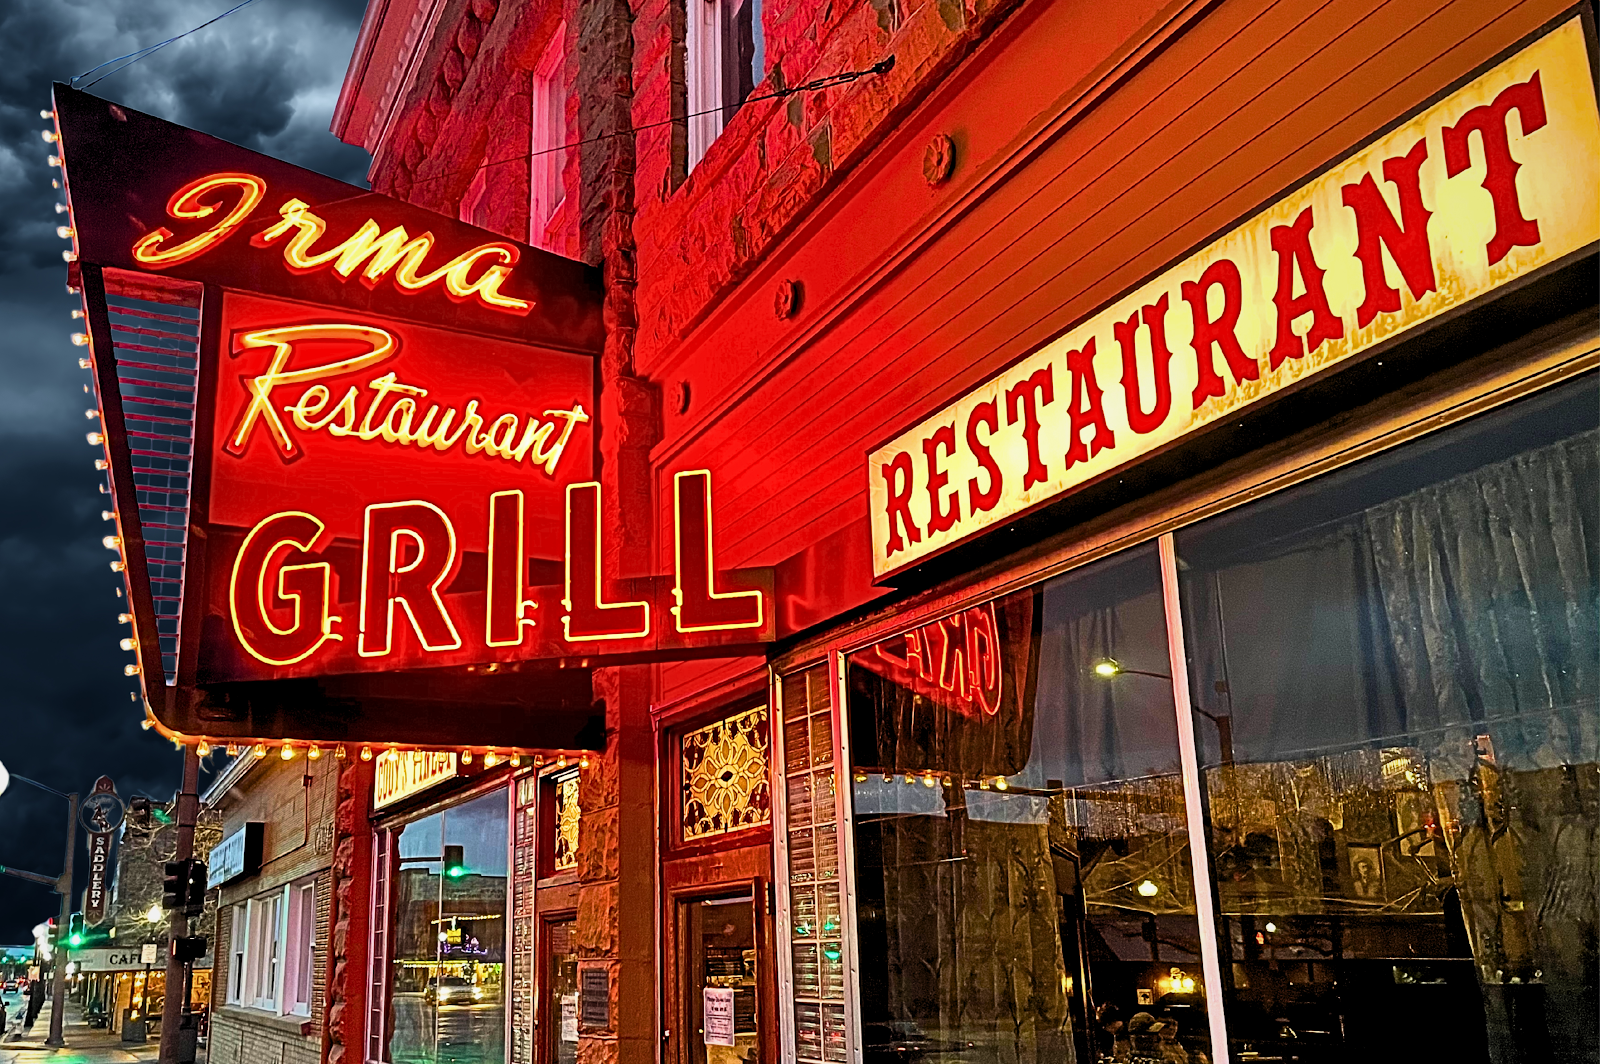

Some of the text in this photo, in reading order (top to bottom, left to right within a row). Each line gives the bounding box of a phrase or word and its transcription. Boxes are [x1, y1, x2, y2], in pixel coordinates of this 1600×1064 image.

[132, 172, 536, 317] Irma
[881, 70, 1548, 559] RESTAURANT
[225, 321, 590, 478] Restaurant
[229, 469, 763, 666] GRILL
[90, 836, 105, 908] SADDLERY
